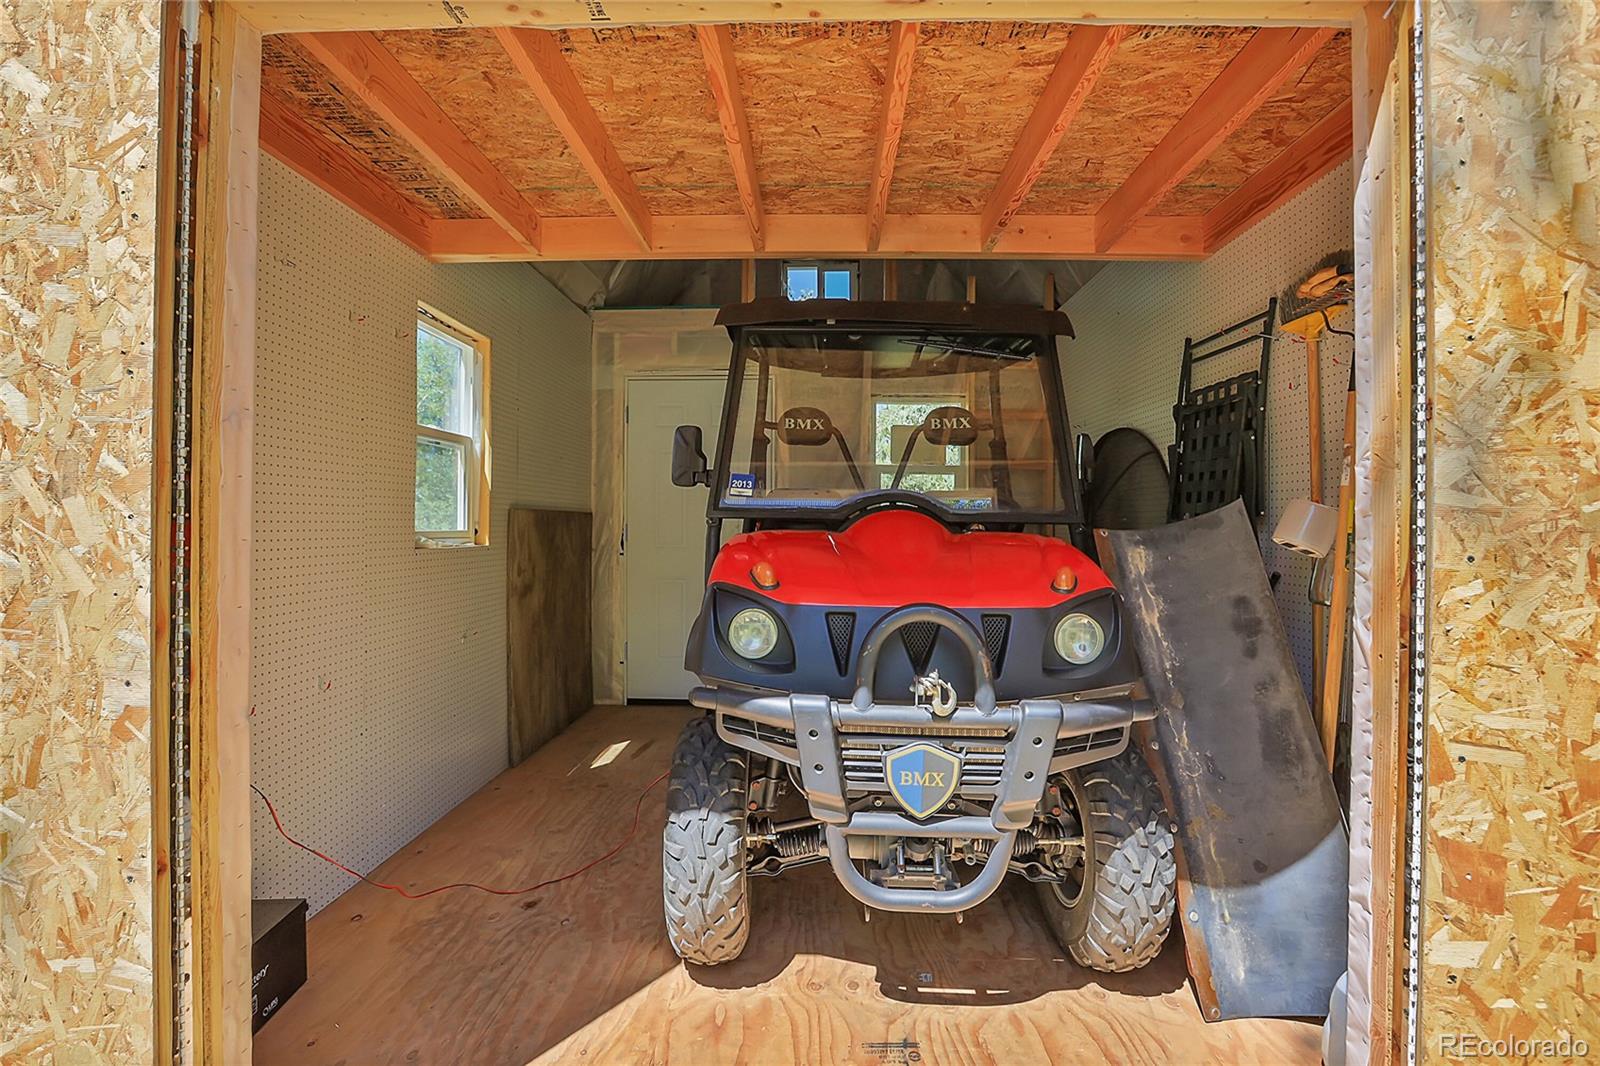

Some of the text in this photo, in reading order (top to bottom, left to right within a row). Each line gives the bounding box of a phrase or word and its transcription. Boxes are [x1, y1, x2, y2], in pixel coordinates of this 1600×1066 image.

[784, 417, 825, 430] BMX
[931, 416, 972, 430] BMX
[731, 479, 753, 489] 2013
[899, 771, 945, 788] BMX
